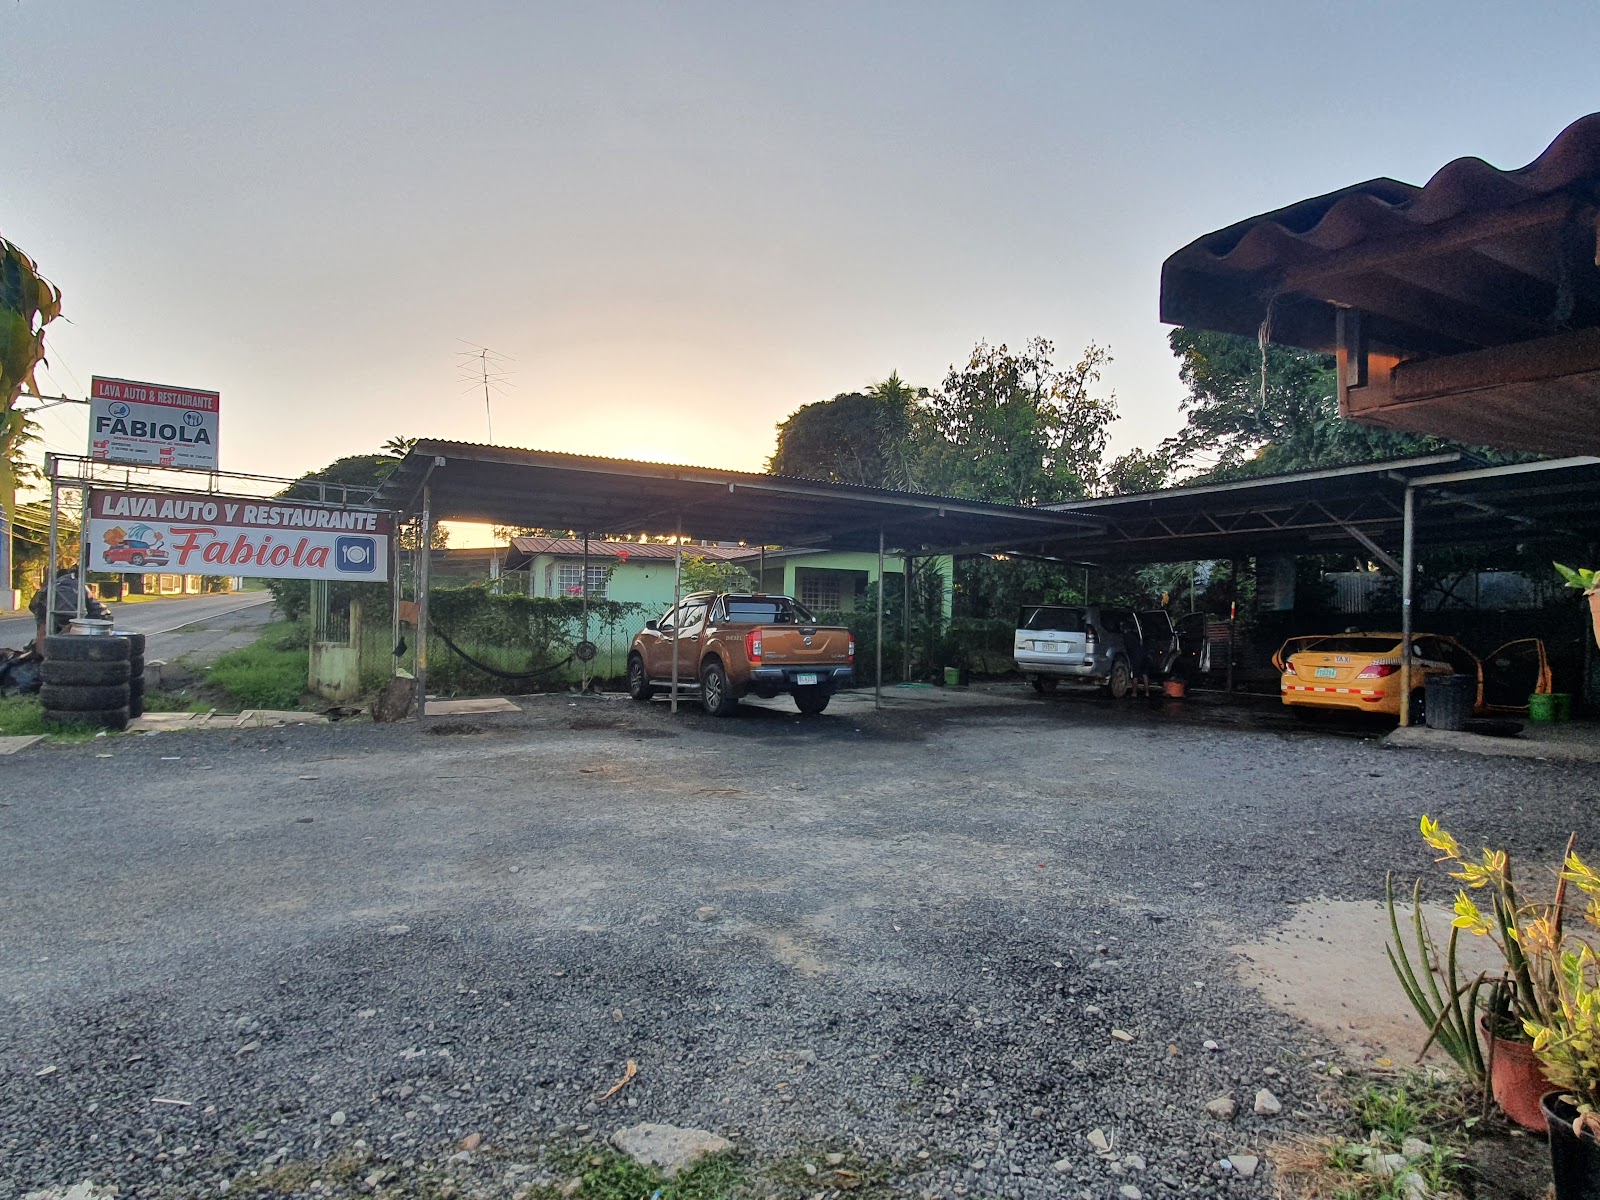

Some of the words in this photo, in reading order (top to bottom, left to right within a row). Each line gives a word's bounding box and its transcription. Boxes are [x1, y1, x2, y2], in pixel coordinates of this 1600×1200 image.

[99, 383, 121, 398] LAVA
[123, 387, 147, 401] AUTO
[148, 392, 156, 402] &
[157, 391, 213, 410] RESTAURANTE
[96, 416, 211, 445] FABIOLA
[102, 496, 157, 517] LAVA
[159, 500, 218, 522] AUTO
[224, 504, 238, 523] Y
[242, 505, 378, 531] RESTAURANTE
[168, 526, 331, 569] Fabiola
